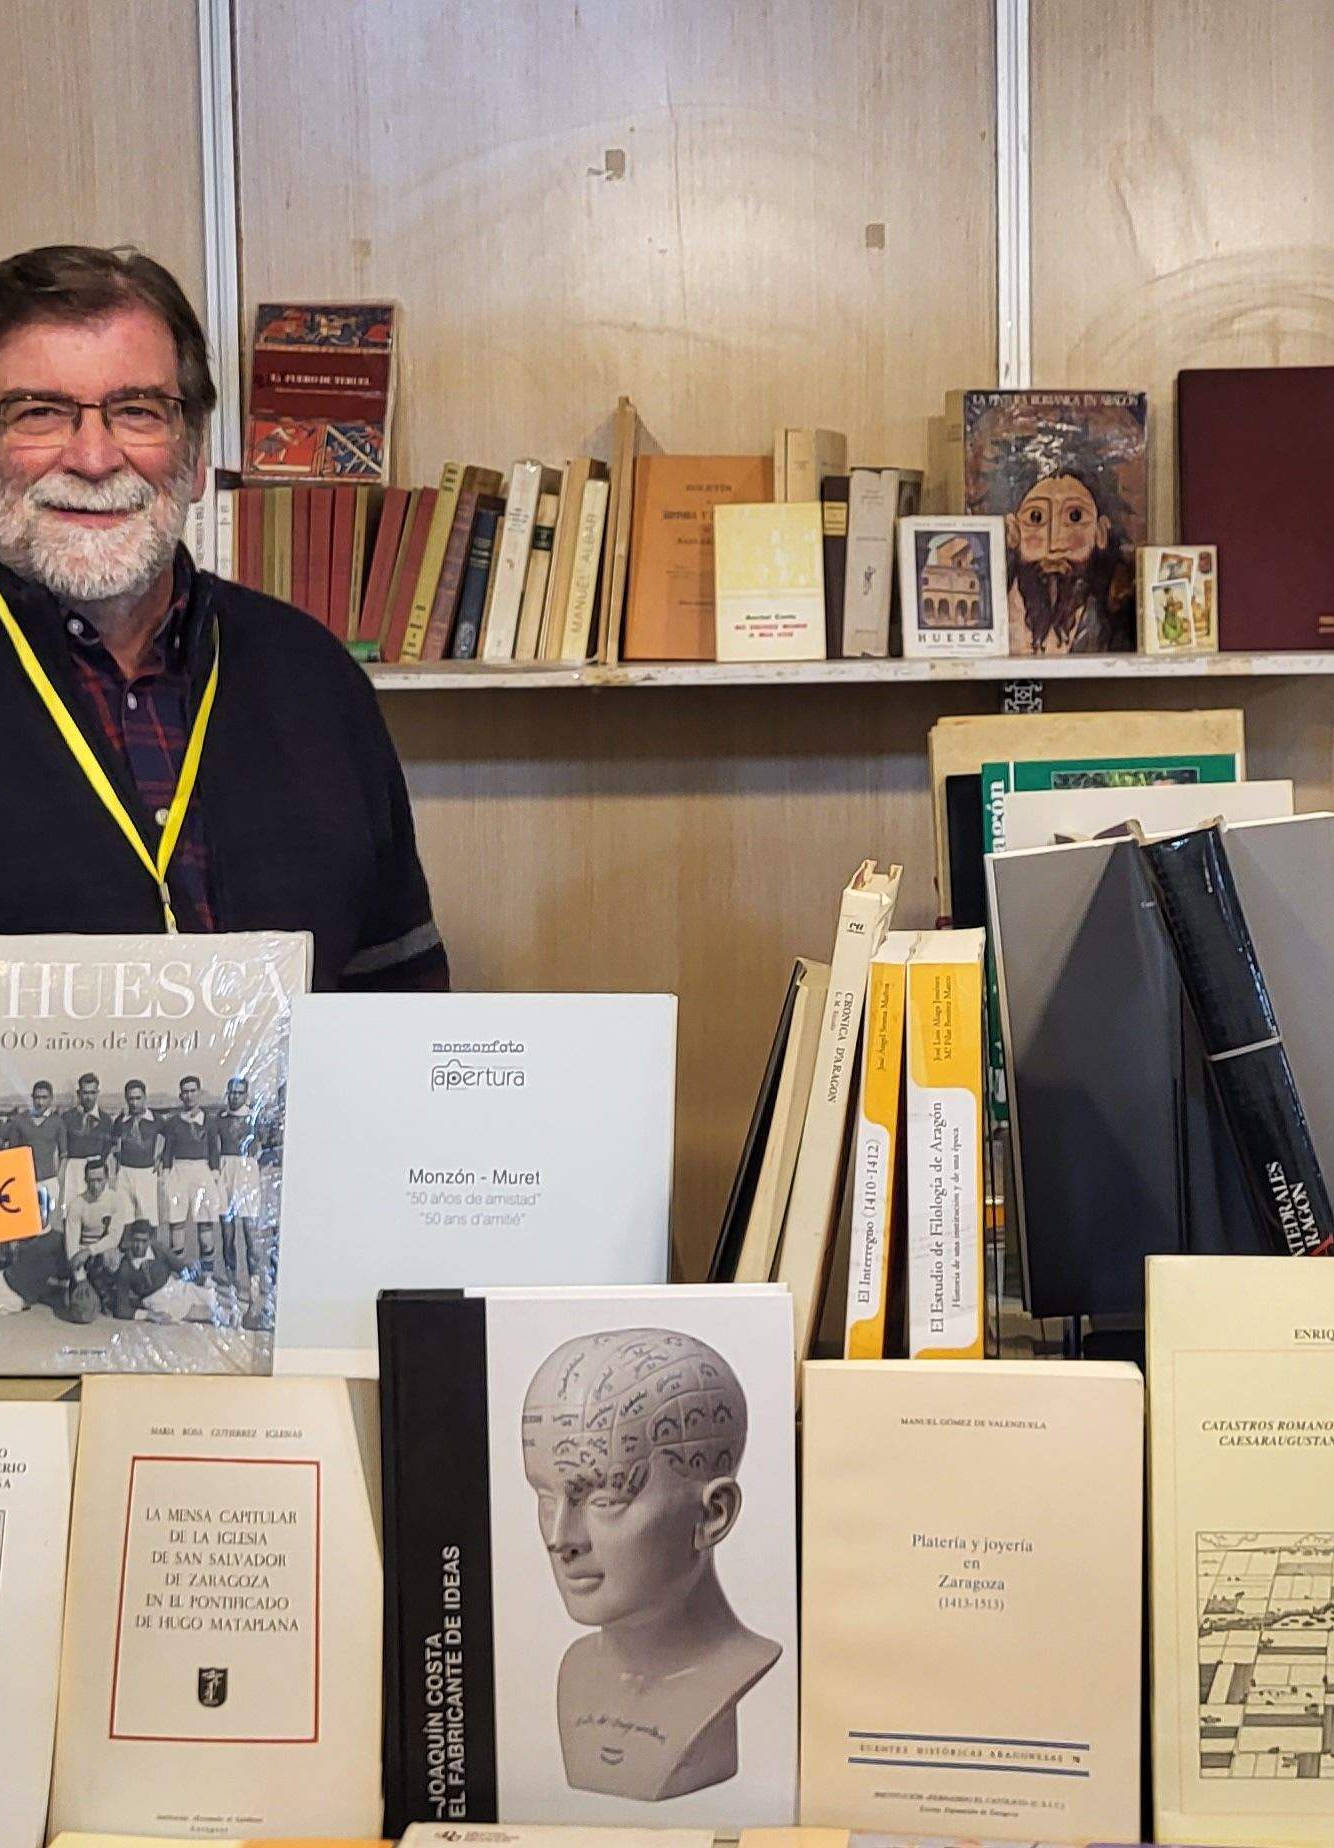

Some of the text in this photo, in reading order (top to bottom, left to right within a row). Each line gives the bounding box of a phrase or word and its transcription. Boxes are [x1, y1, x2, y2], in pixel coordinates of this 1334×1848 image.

[918, 631, 995, 644] HUESCA
[1, 958, 294, 1022] HUESCA
[45, 1030, 96, 1051] años
[102, 1029, 128, 1051] de
[135, 1029, 200, 1051] fútbol
[431, 1039, 525, 1054] monzonfoto
[431, 1063, 525, 1091] apertura
[951, 1127, 963, 1153] época
[408, 1167, 541, 1185] Monzón Muret
[430, 1191, 464, 1206] años
[464, 1191, 484, 1206] de
[929, 1101, 948, 1334] El Estudio de Filología de Aragón
[1265, 1161, 1306, 1257] ATEDRALES
[443, 1213, 468, 1226] ans
[857, 1138, 882, 1304] El Interregno (1410-1412)
[951, 1271, 961, 1308] Historia
[182, 1427, 204, 1438] ROSA
[900, 1417, 939, 1427] MANUEL
[973, 1418, 986, 1428] DE
[987, 1419, 1047, 1431] VALENZUELA
[1201, 1420, 1274, 1432] CATASTROS
[145, 1506, 299, 1525] LA MENSA CAPITULAR
[169, 1530, 269, 1546] DE LA IGLESIA
[911, 1533, 1034, 1555] Platería y joyería
[151, 1551, 288, 1568] DE SAN SALVADOR
[963, 1558, 981, 1570] en
[164, 1572, 271, 1590] DE ZARAGOZA
[938, 1574, 1006, 1593] Zaragoza
[145, 1593, 290, 1611] EN EL PONTIFICADO
[135, 1614, 300, 1633] DE HUGO MATAPLANA
[442, 1544, 467, 1818] EL FABRICANTE DE IDEAS
[424, 1631, 446, 1819] JOAQUÍN COSTA
